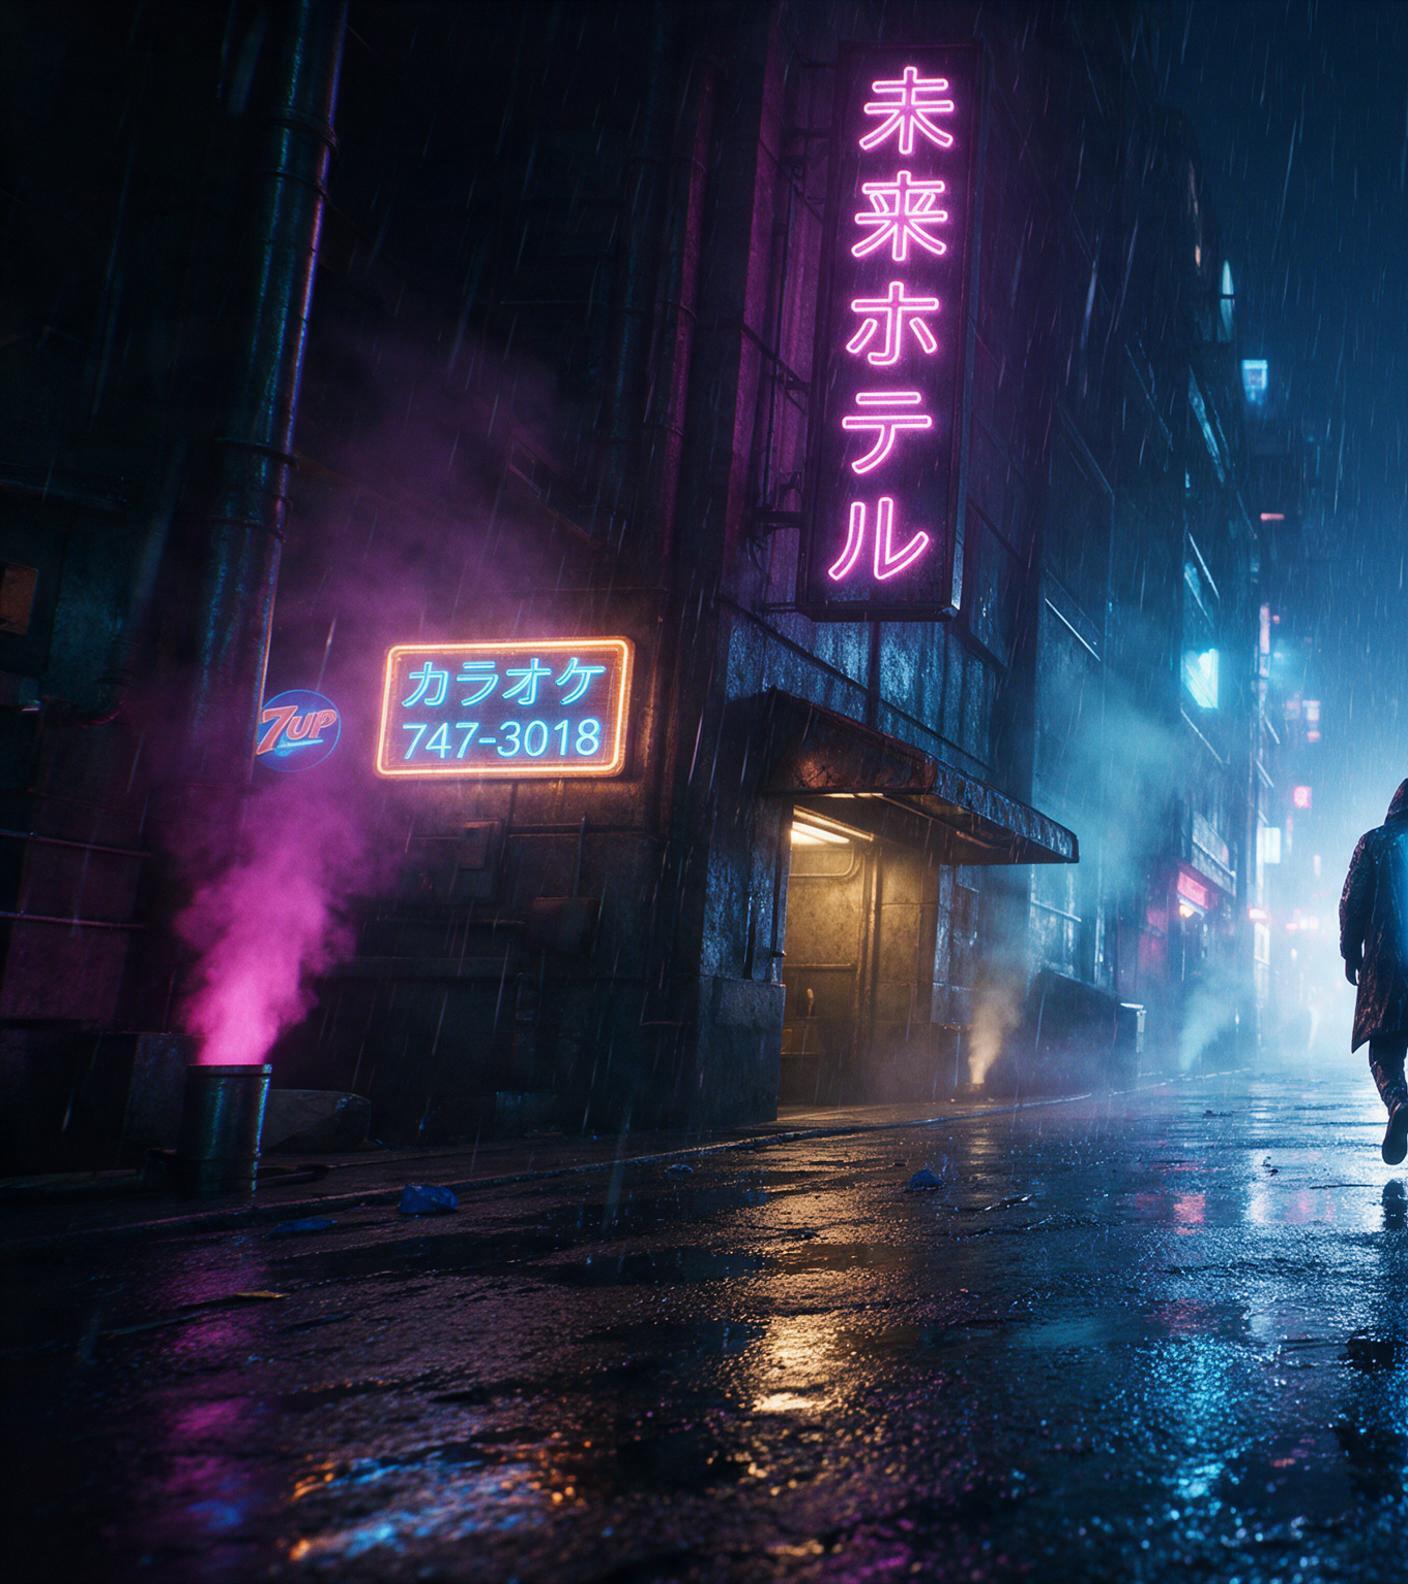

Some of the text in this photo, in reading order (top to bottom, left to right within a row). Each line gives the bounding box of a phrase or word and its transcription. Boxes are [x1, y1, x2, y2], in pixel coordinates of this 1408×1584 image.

[828, 66, 955, 581] 未来ホテル
[401, 657, 607, 708] カラオケ
[402, 718, 601, 760] 747-3018
